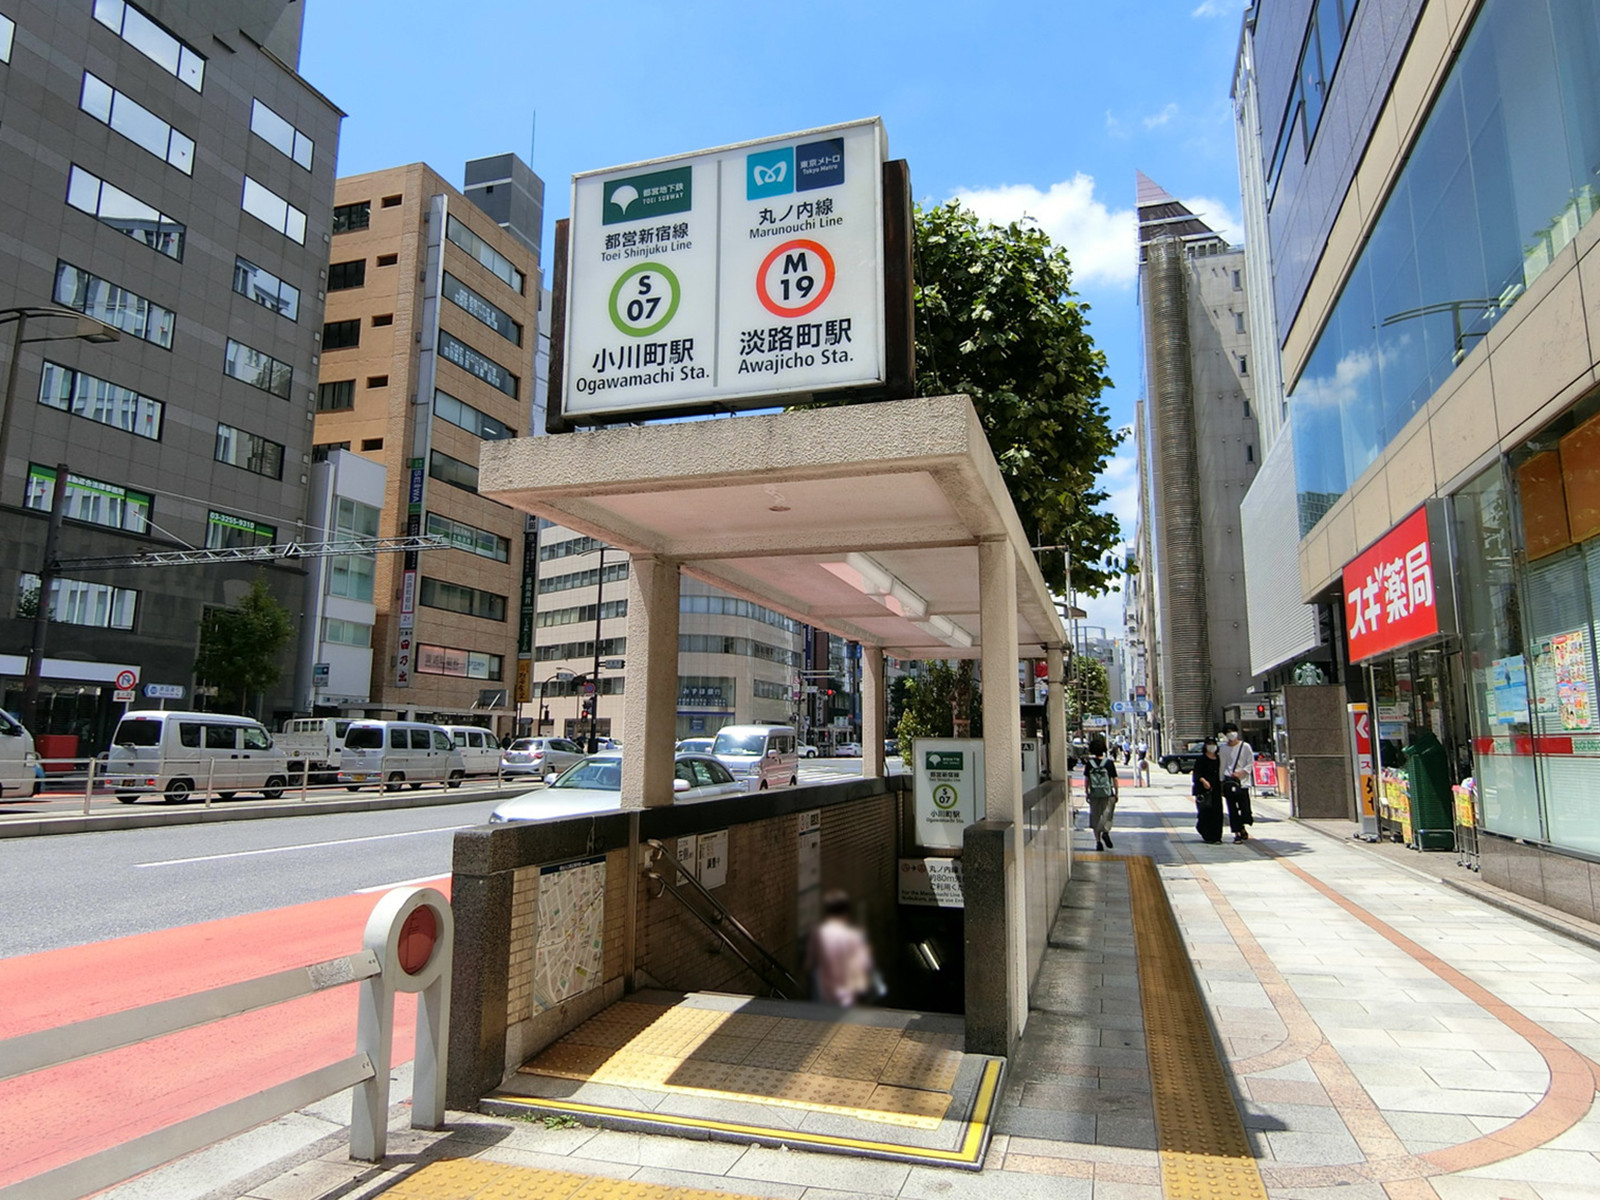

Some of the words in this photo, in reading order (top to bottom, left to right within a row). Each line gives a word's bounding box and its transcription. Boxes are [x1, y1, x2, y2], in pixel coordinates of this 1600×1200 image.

[799, 154, 840, 169] 東京メトロ
[802, 166, 819, 176] Tokyo
[820, 163, 838, 172] Metro
[642, 182, 684, 197] 都営地下鉄
[642, 196, 657, 205] TOEI
[657, 192, 684, 202] SUBWAY
[758, 197, 833, 226] 丸ノ内線
[604, 221, 689, 251] 都営新宿線
[749, 218, 816, 239] Marunouchi
[819, 215, 843, 229] Line
[601, 249, 621, 262] Toei
[624, 243, 668, 259] Shinjuku
[670, 240, 692, 252] Line
[782, 252, 808, 275] M
[637, 274, 652, 295] S
[780, 275, 815, 301] 19
[626, 296, 662, 322] 07
[738, 317, 852, 356] 淡路町駅
[591, 337, 694, 373] 小川町駅
[738, 349, 815, 375] Awajicho
[820, 347, 853, 364] Sta.
[576, 368, 675, 395] Ogawamachi
[680, 365, 709, 381] Sta.
[1348, 543, 1433, 639] スギ薬局
[939, 795, 951, 804] 07
[942, 787, 948, 795] S
[930, 809, 960, 818] 小川町駅
